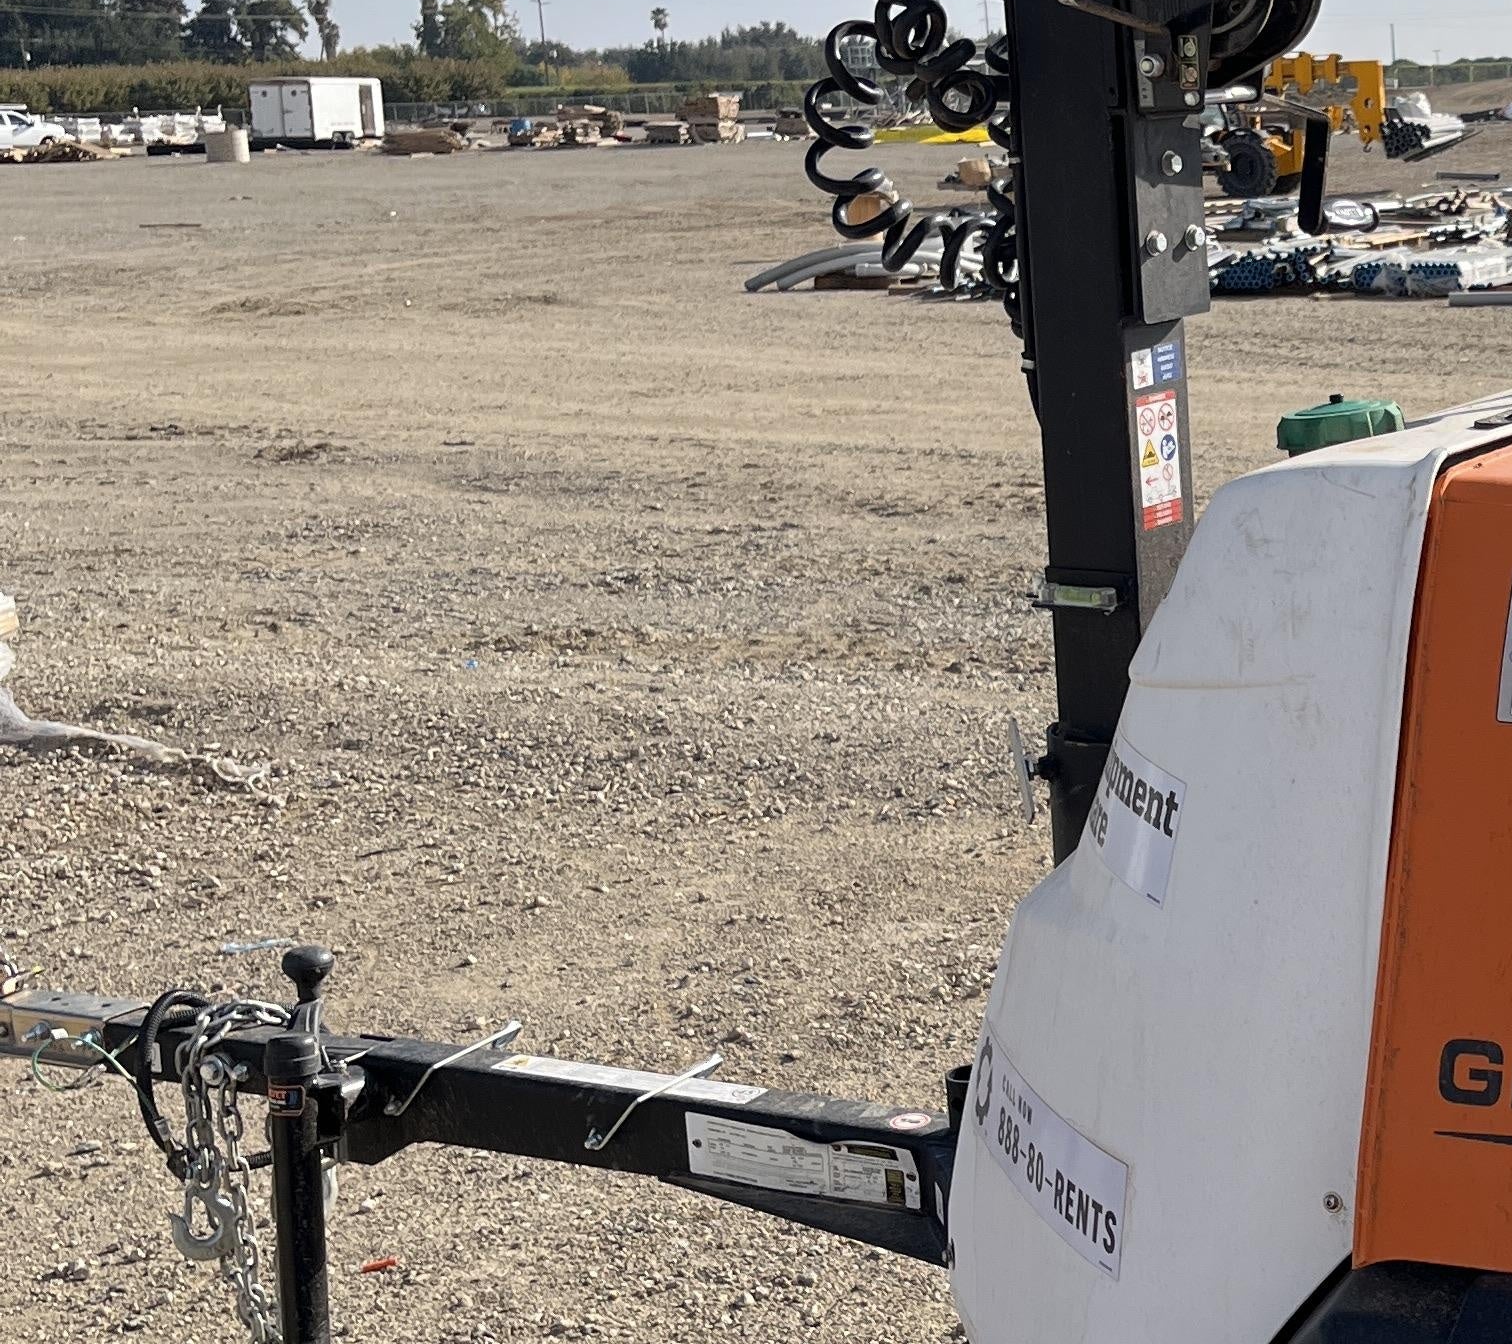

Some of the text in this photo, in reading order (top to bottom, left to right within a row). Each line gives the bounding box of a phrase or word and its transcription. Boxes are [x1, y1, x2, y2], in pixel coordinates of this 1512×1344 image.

[1002, 1074, 1033, 1125] CALL NOW
[998, 1106, 1117, 1254] 888-80-RENTS
